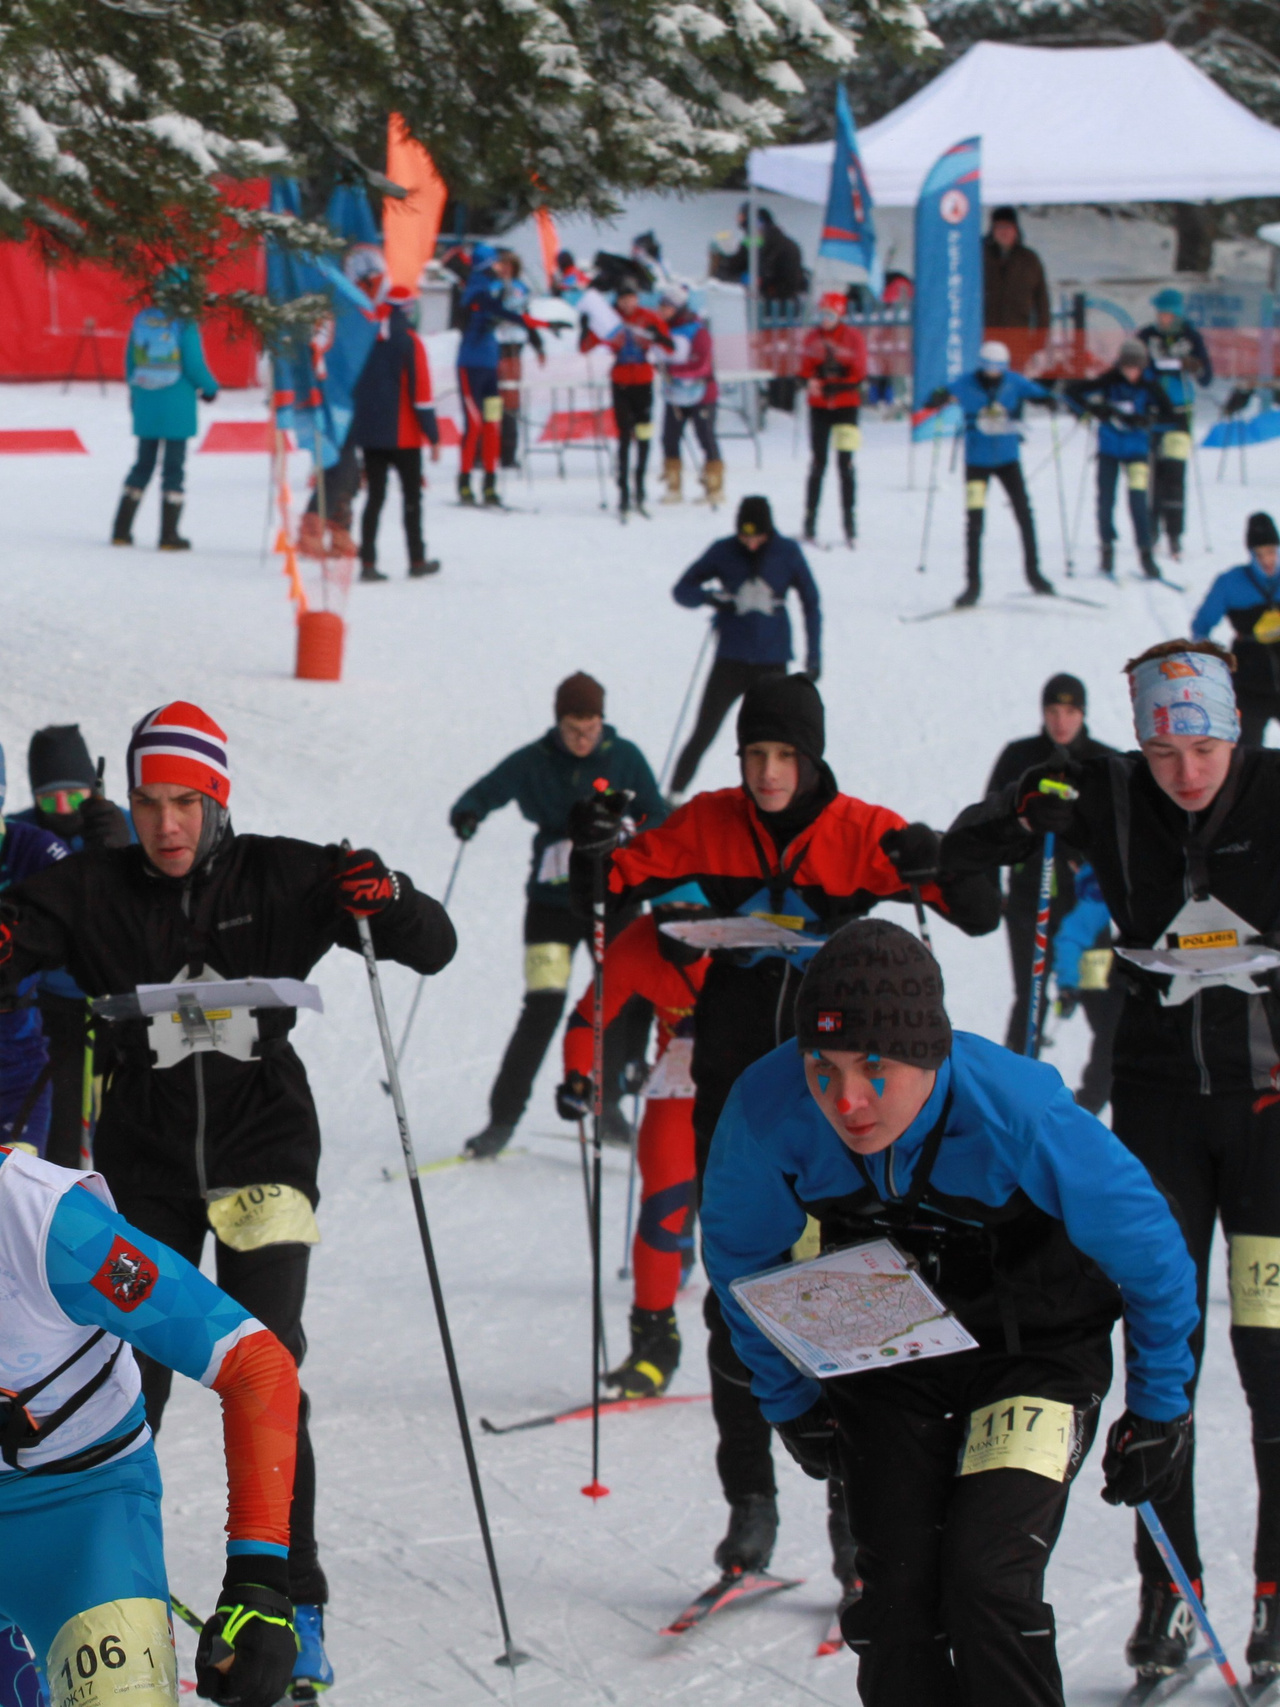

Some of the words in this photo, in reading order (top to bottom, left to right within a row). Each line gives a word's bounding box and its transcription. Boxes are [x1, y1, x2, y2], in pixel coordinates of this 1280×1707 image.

[1182, 933, 1234, 945] POLARIS
[234, 1184, 282, 1213] 103
[982, 1405, 1044, 1437] 117
[60, 1634, 127, 1690] 106
[143, 1647, 155, 1669] 1
